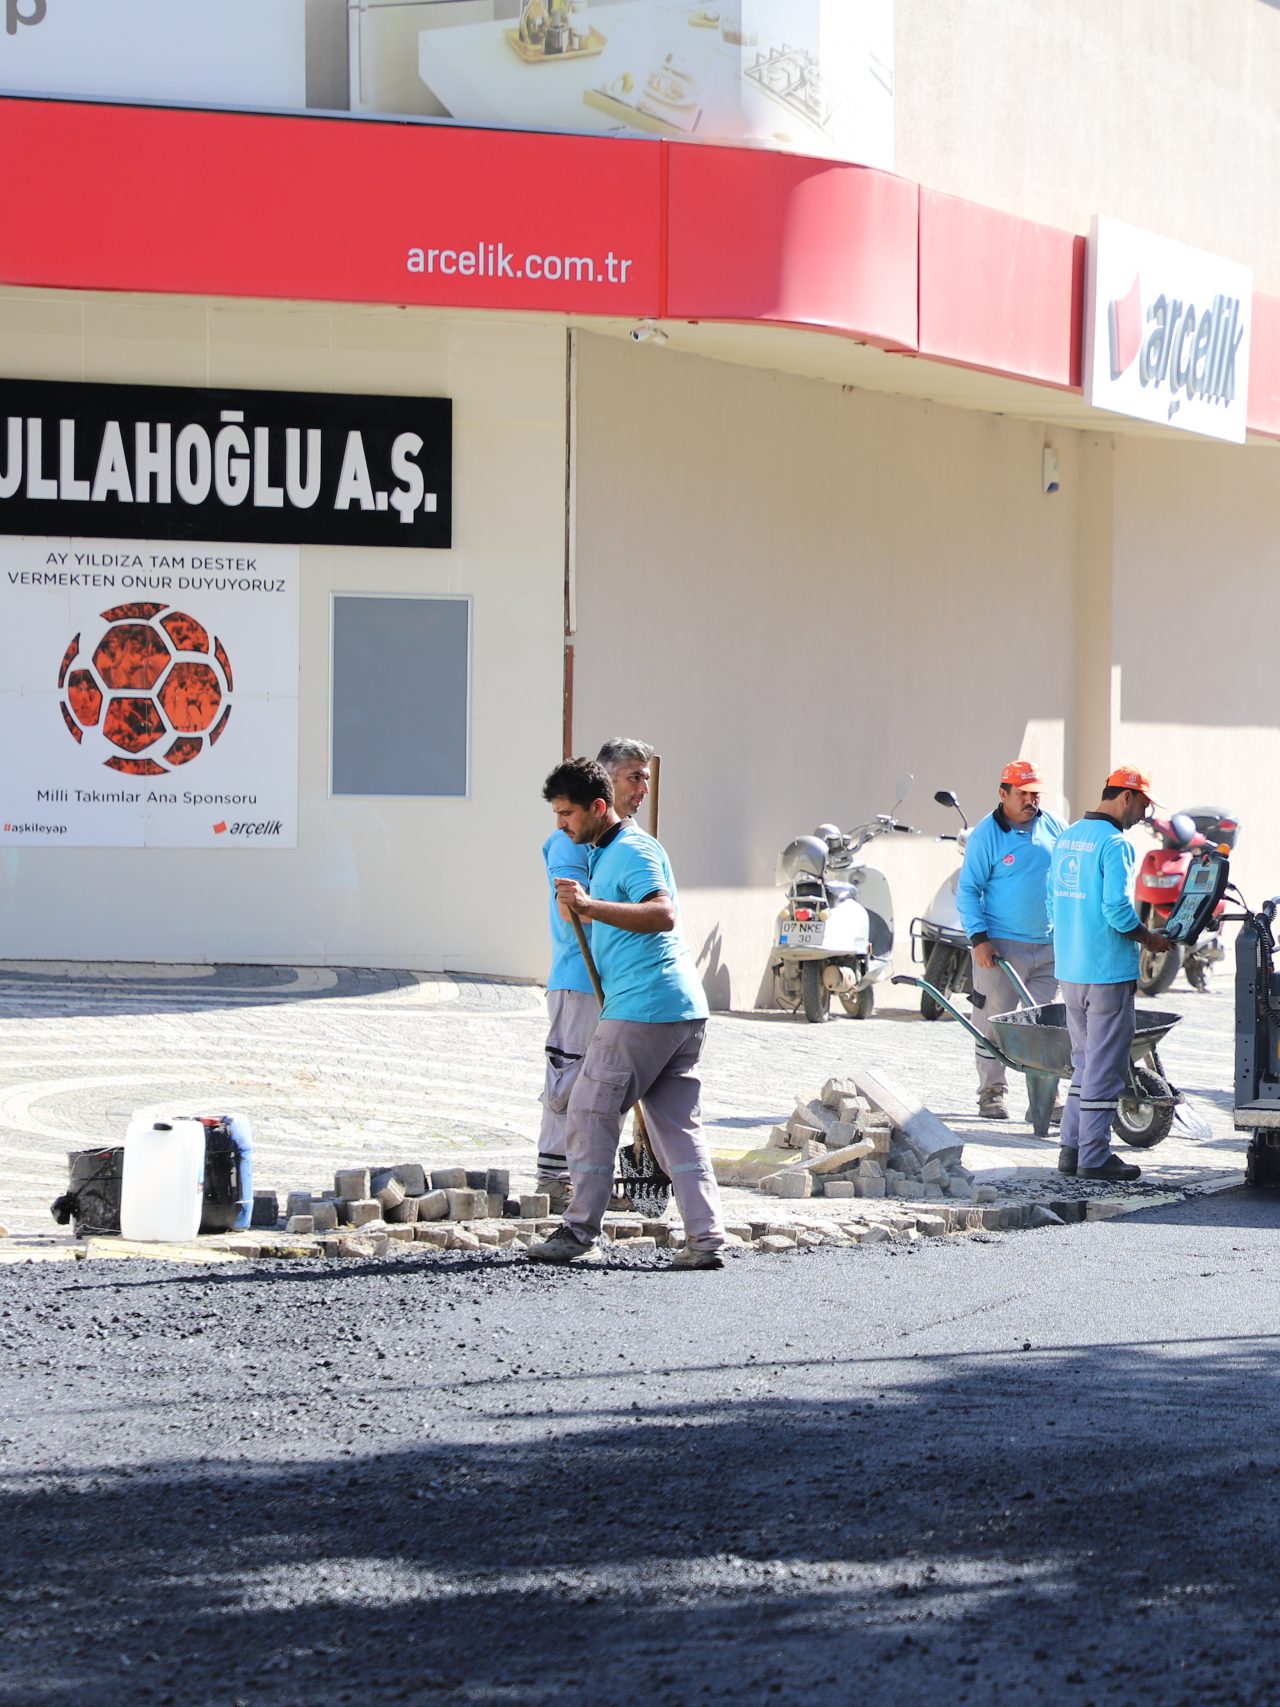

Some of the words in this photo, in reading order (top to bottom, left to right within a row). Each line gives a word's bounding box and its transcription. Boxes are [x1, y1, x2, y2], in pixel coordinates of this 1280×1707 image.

[406, 241, 632, 284] arcelik.com.tr
[1139, 293, 1244, 422] arçelik
[334, 430, 437, 524] A.Ş.
[46, 552, 68, 565] AY
[74, 553, 143, 568] YILDIZA
[150, 555, 185, 569] TAM
[191, 557, 257, 571] DESTEK
[8, 571, 115, 588] VERMEKTEN
[121, 575, 173, 589] ONUR
[178, 577, 286, 593] DUYUYORUZ
[37, 790, 68, 803] Milli
[74, 790, 141, 804] Takımlar
[147, 791, 177, 804] Ana
[183, 792, 257, 806] Sponsoru
[229, 820, 283, 838] arçelik
[783, 923, 797, 932] 07
[800, 923, 823, 933] NKE
